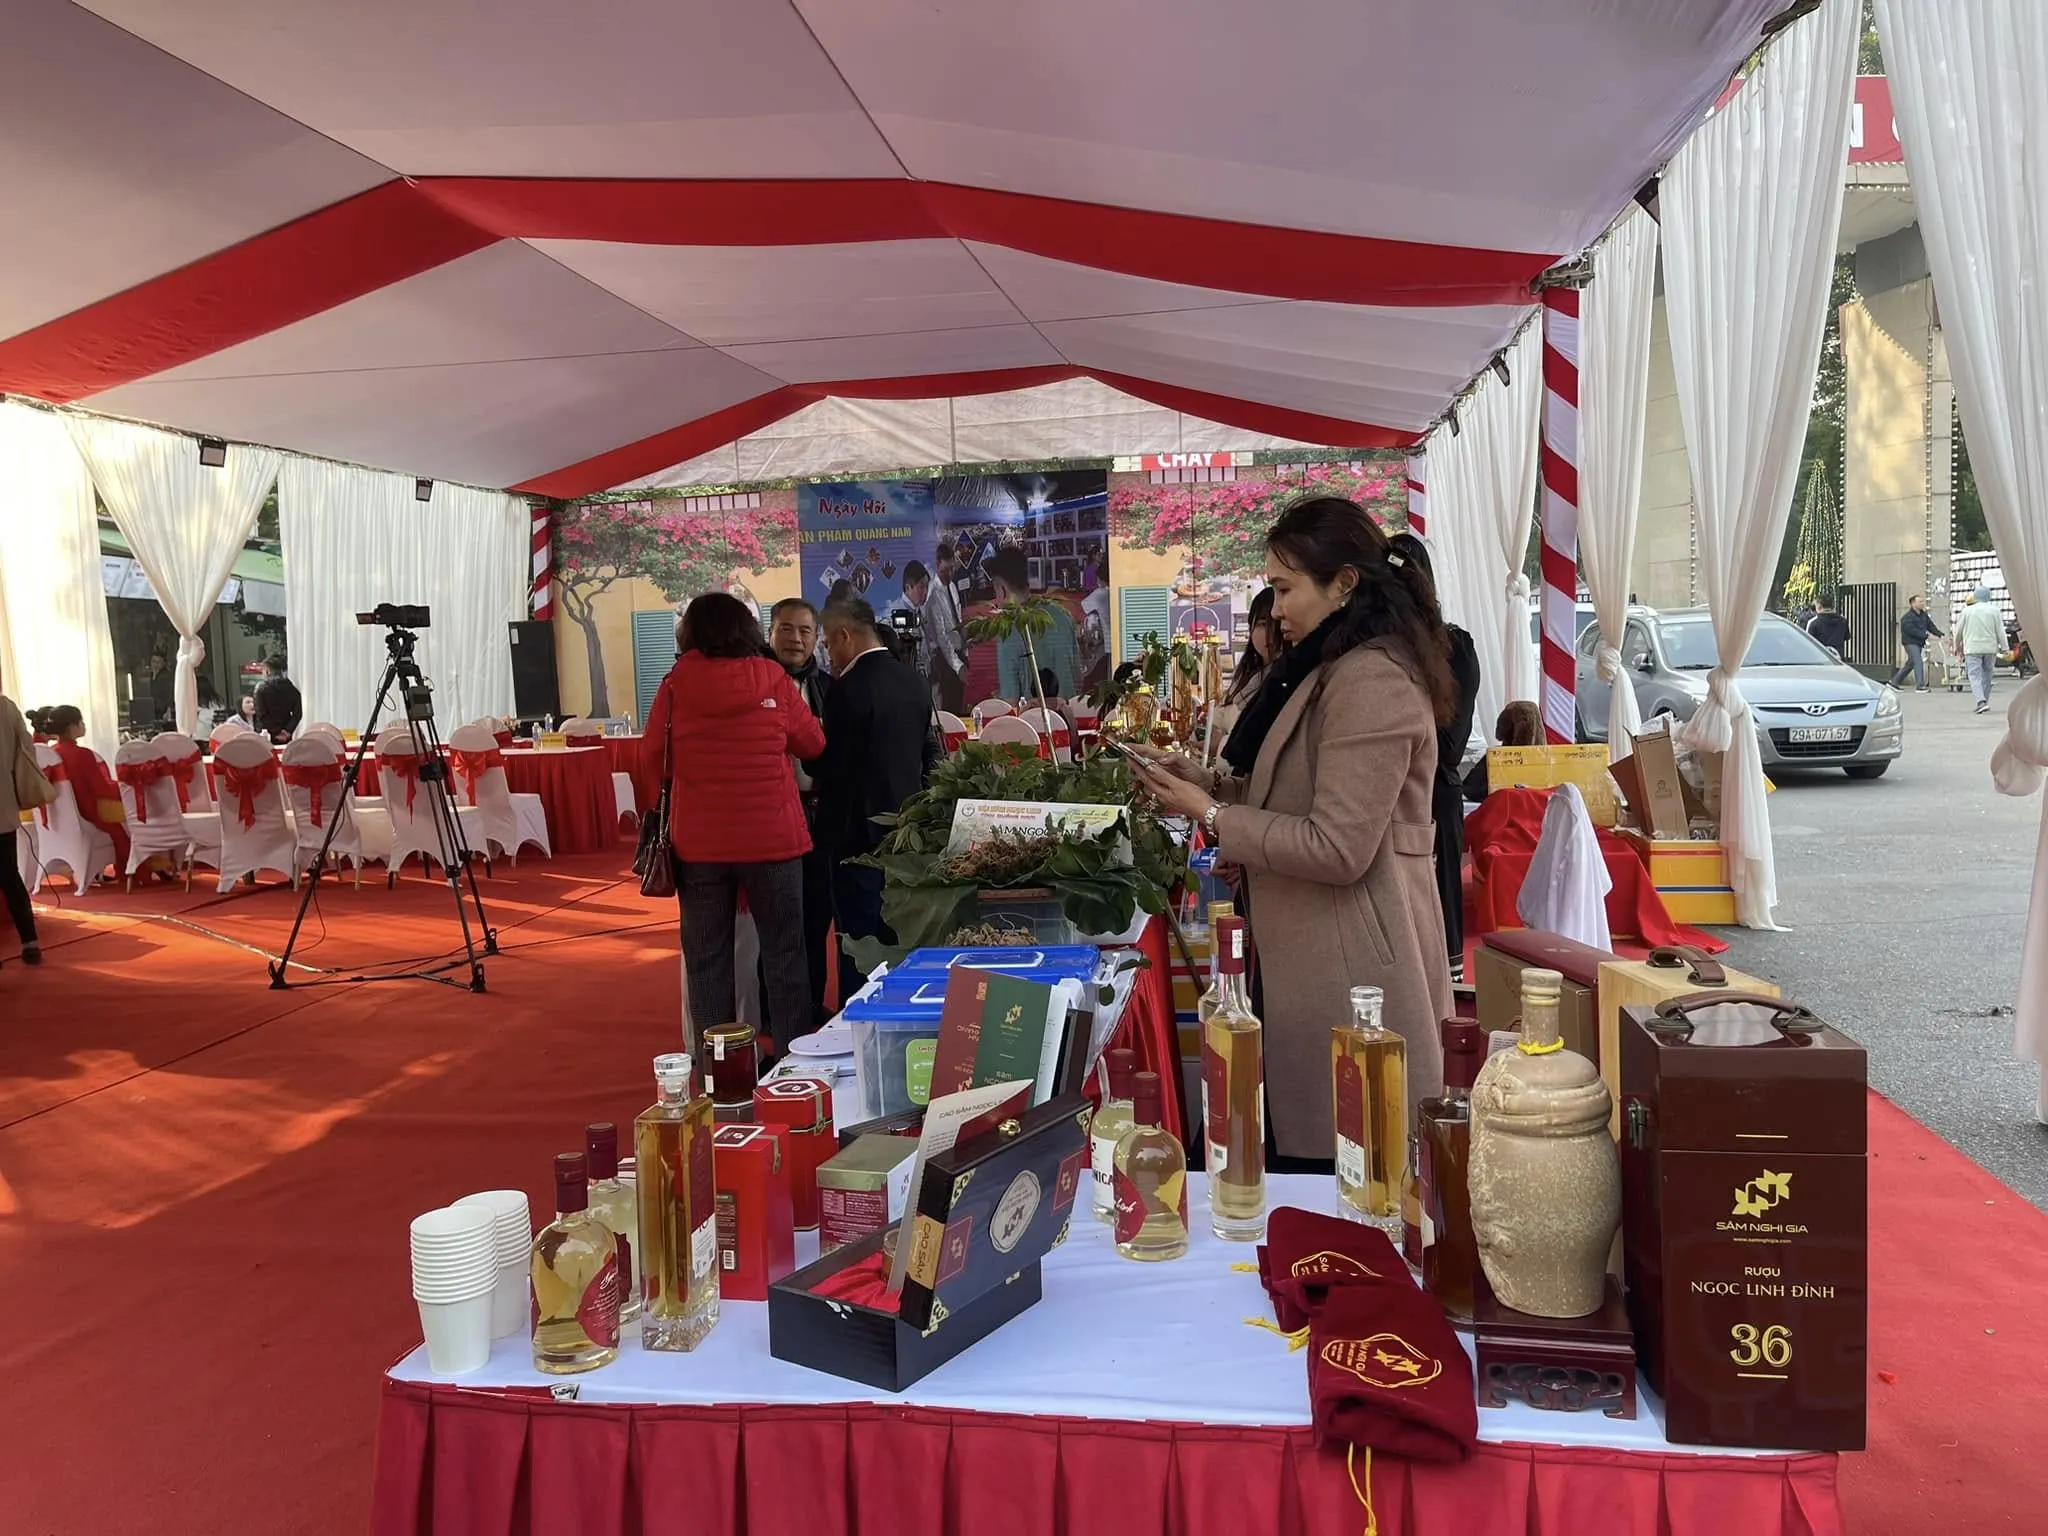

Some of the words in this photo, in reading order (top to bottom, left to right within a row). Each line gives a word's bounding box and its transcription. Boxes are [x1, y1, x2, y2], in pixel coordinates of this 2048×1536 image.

[1785, 1224, 1809, 1234] GIA
[1744, 1266, 1781, 1278] RƯỢU
[1691, 1281, 1740, 1297] NGỌC
[1746, 1283, 1785, 1297] LINH
[1730, 1323, 1792, 1367] 36
